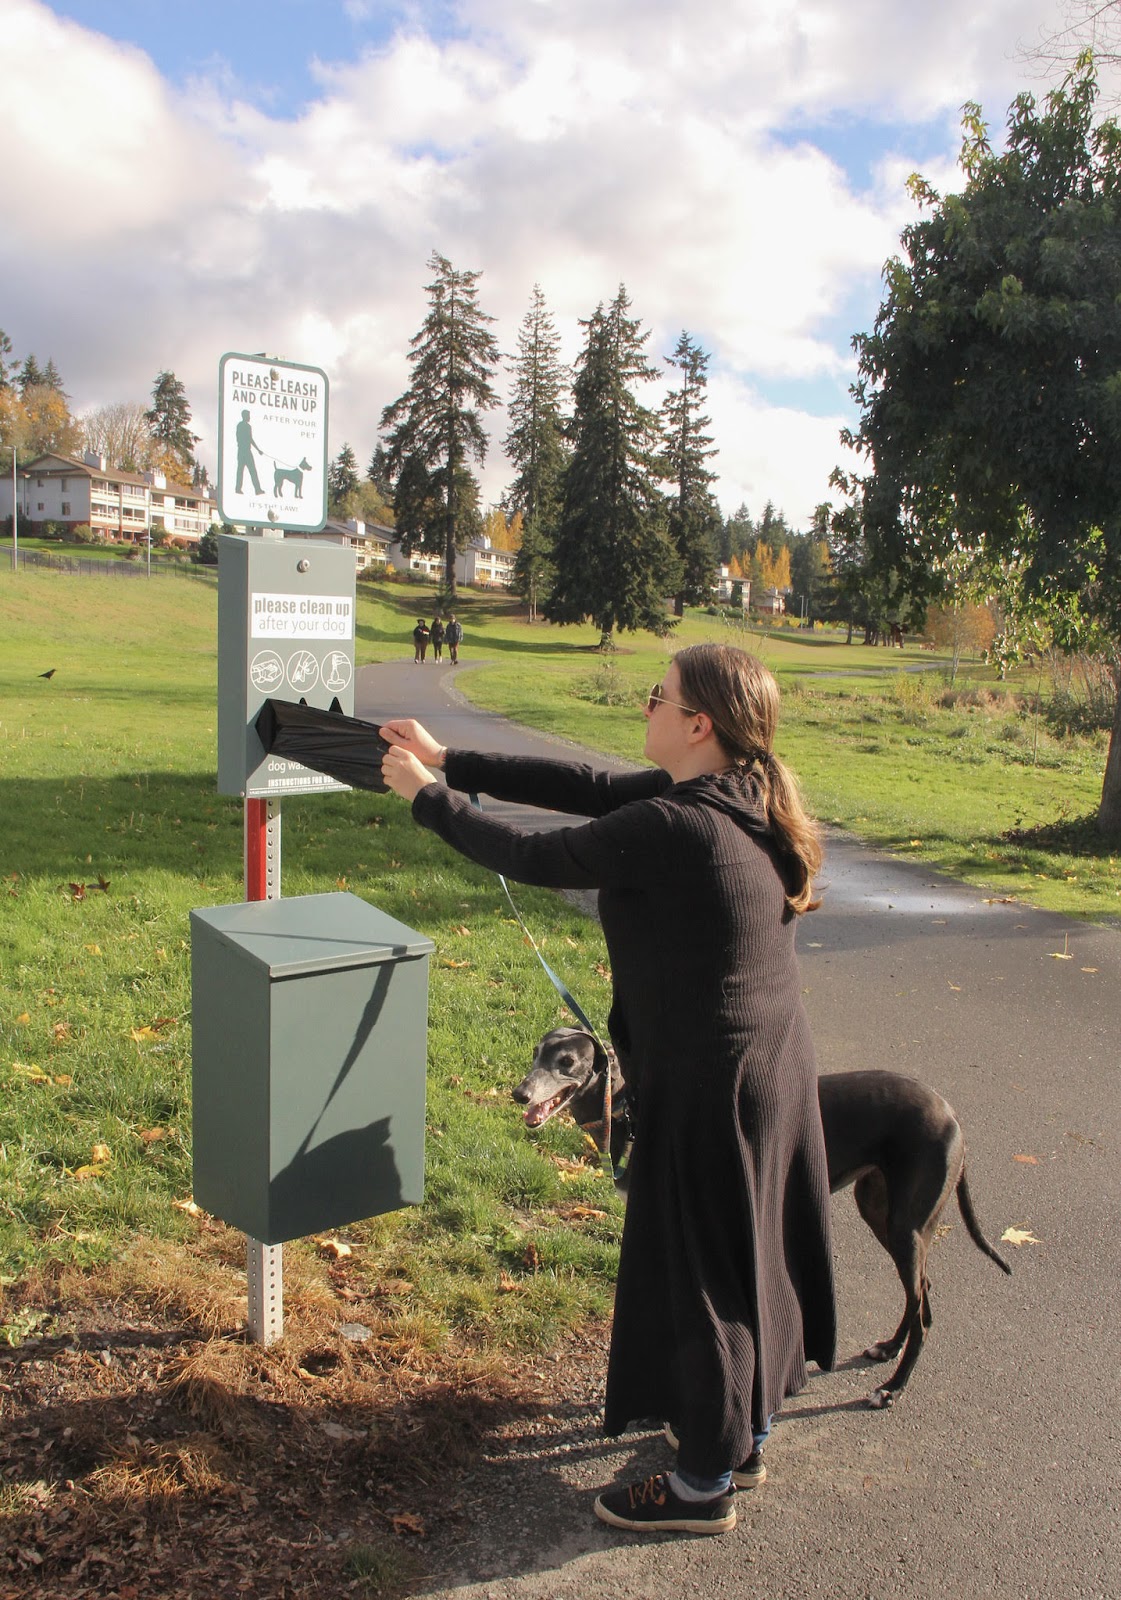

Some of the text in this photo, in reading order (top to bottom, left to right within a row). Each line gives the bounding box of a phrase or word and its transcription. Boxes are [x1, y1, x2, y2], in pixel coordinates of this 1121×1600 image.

[232, 371, 317, 397] PLEASE LEASH
[232, 389, 317, 413] AND CLEAN UP
[263, 414, 316, 427] AFTER YOUR
[300, 431, 316, 439] PET
[254, 598, 349, 617] please clean up
[259, 615, 346, 635] after your dog
[268, 761, 286, 773] dog
[268, 777, 311, 787] INSTRUCTIONS
[312, 776, 323, 784] FOR
